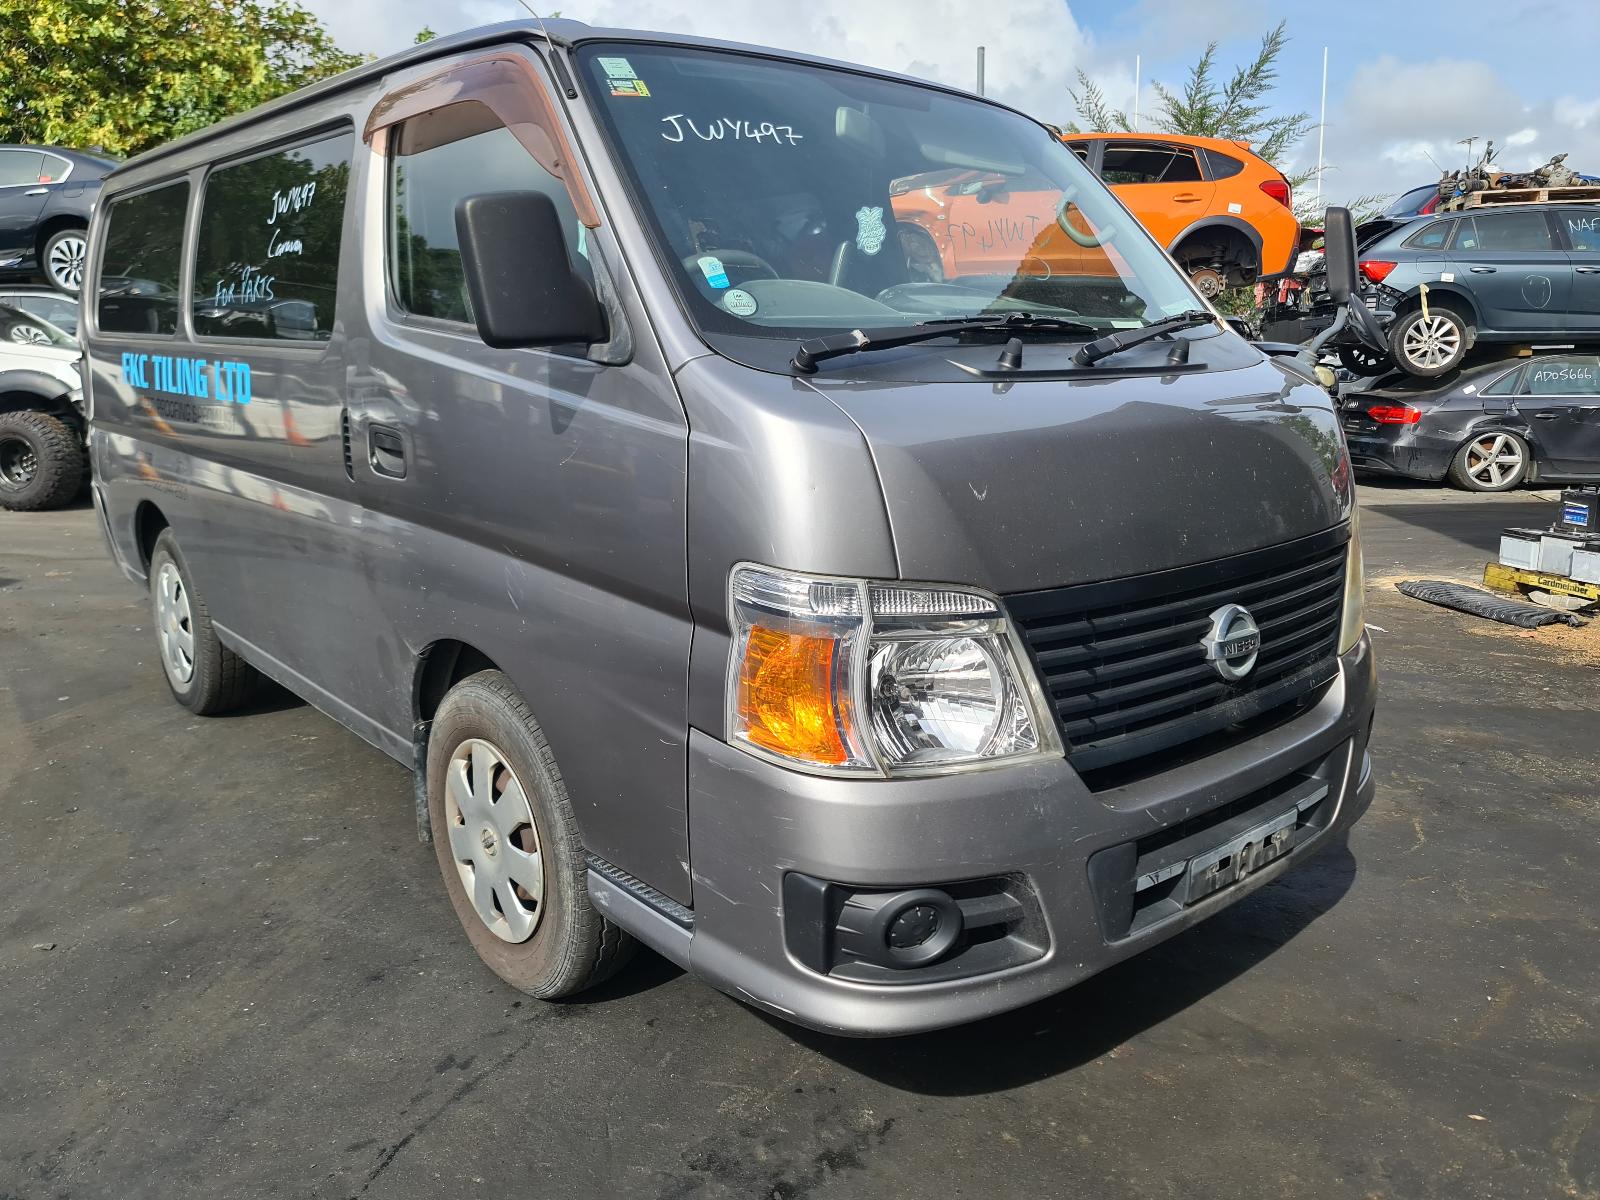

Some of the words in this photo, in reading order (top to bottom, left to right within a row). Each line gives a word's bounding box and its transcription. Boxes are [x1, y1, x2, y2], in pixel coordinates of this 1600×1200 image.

[661, 114, 804, 146] JWY497
[152, 355, 208, 398] TILING
[214, 360, 252, 405] LTD
